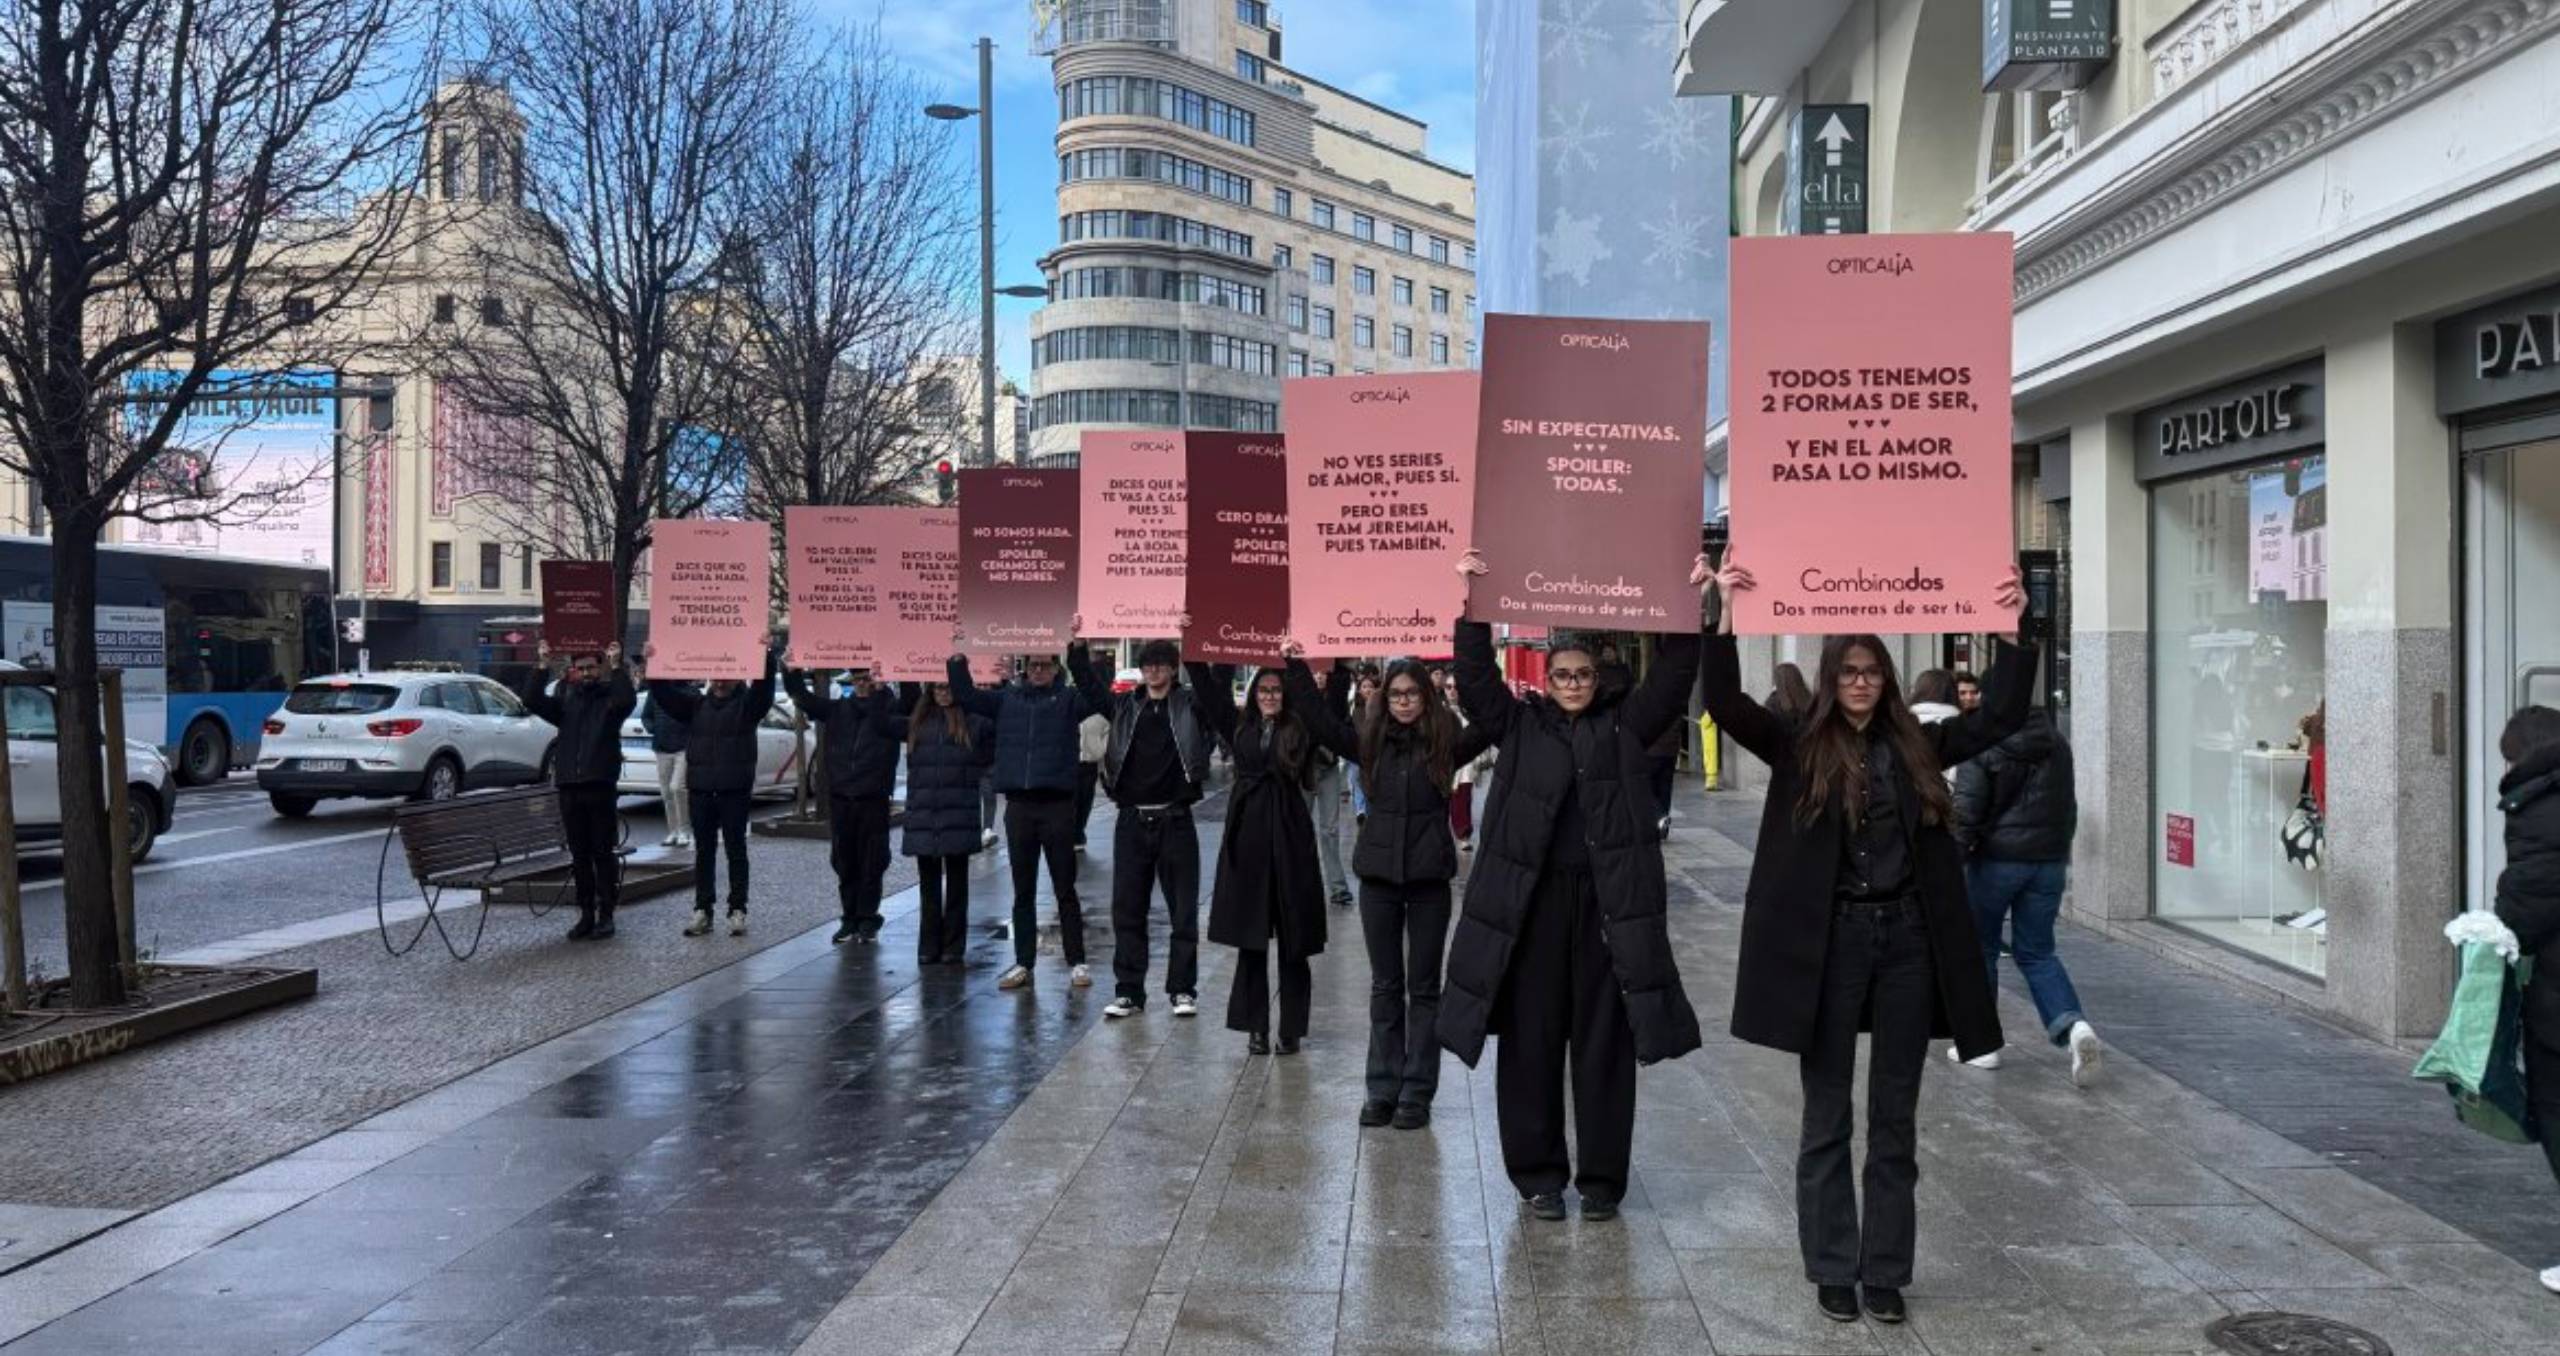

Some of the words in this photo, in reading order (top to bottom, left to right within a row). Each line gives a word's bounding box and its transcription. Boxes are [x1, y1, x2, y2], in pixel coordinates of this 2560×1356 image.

[2015, 31, 2105, 41] RESTAURANTE
[2015, 45, 2080, 56] PLANTA
[2089, 46, 2105, 56] 10
[1804, 174, 1860, 203] ella
[2476, 311, 2560, 380] PA
[1768, 369, 1851, 388] TODOS
[1858, 367, 1971, 386] TENEMOS
[1762, 395, 1775, 412] 2
[1783, 394, 1883, 412] FORMAS
[1891, 393, 1920, 410] DE
[1928, 392, 1977, 412] SER,
[2160, 383, 2292, 457] PARFOIS
[1502, 419, 1533, 434] SIN
[1539, 421, 1680, 441] EXPECTATIVAS.
[1787, 440, 1801, 457] Y
[1809, 440, 1837, 457] EN
[1846, 439, 1871, 456] EL
[1880, 438, 1952, 456] AMOR
[1323, 457, 1348, 469] NO
[1354, 455, 1384, 468] VES
[1390, 453, 1443, 467] SERIES
[1547, 457, 1632, 474] SPOILER:
[1308, 474, 1328, 487] DE
[1334, 472, 1390, 486] AMOR,
[1395, 470, 1435, 484] PUES
[1773, 464, 1831, 481] PASA
[1839, 463, 1870, 481] LO
[1879, 462, 1967, 480] MISMO.
[1110, 479, 1144, 489] DICES
[1149, 479, 1174, 490] QUE
[1553, 476, 1623, 493] TODAS.
[1102, 492, 1116, 501] TE
[1120, 492, 1142, 501] VAS
[1146, 492, 1154, 501] A
[1129, 505, 1158, 515] PUES
[1216, 511, 1251, 523] CERO
[1341, 505, 1384, 517] PERO
[1389, 503, 1428, 516] ERES
[974, 528, 990, 537] NO
[994, 528, 1034, 537] SOMOS
[1038, 528, 1072, 537] NADA.
[1115, 529, 1146, 538] PERO
[1317, 523, 1362, 535] TEAM
[1367, 520, 1454, 534] JEREMIAH,
[1126, 541, 1140, 551] LA
[1144, 541, 1178, 551] BODA
[1326, 539, 1364, 552] PUES
[1370, 535, 1445, 551] TAMBIÉN.
[902, 552, 931, 560] DICES
[999, 550, 1048, 559] SPOILER:
[704, 562, 726, 572] QUE
[729, 563, 746, 571] NO
[981, 561, 1037, 570] CENAMOS
[1040, 561, 1065, 570] CON
[1107, 567, 1136, 576] PUES
[671, 573, 712, 581] ESPERA
[990, 572, 1008, 581] MIS
[1012, 572, 1056, 581] PADRES.
[1800, 567, 1944, 592] Combinados
[1525, 572, 1643, 597] Combinados
[679, 604, 740, 614] TENEMOS
[1500, 596, 1527, 610] Dos
[1532, 601, 1594, 613] maneras
[1600, 602, 1616, 615] de
[1622, 606, 1643, 616] ser
[1773, 601, 1805, 616] Dos
[1812, 604, 1887, 615] maneras
[1894, 601, 1915, 614] de
[1922, 603, 1948, 614] ser
[1956, 600, 1976, 614] tú.
[671, 616, 687, 624] SU
[691, 617, 748, 627] REGALO.
[1337, 608, 1436, 627] Combinados
[1318, 633, 1340, 645] Dos
[1401, 633, 1416, 643] de
